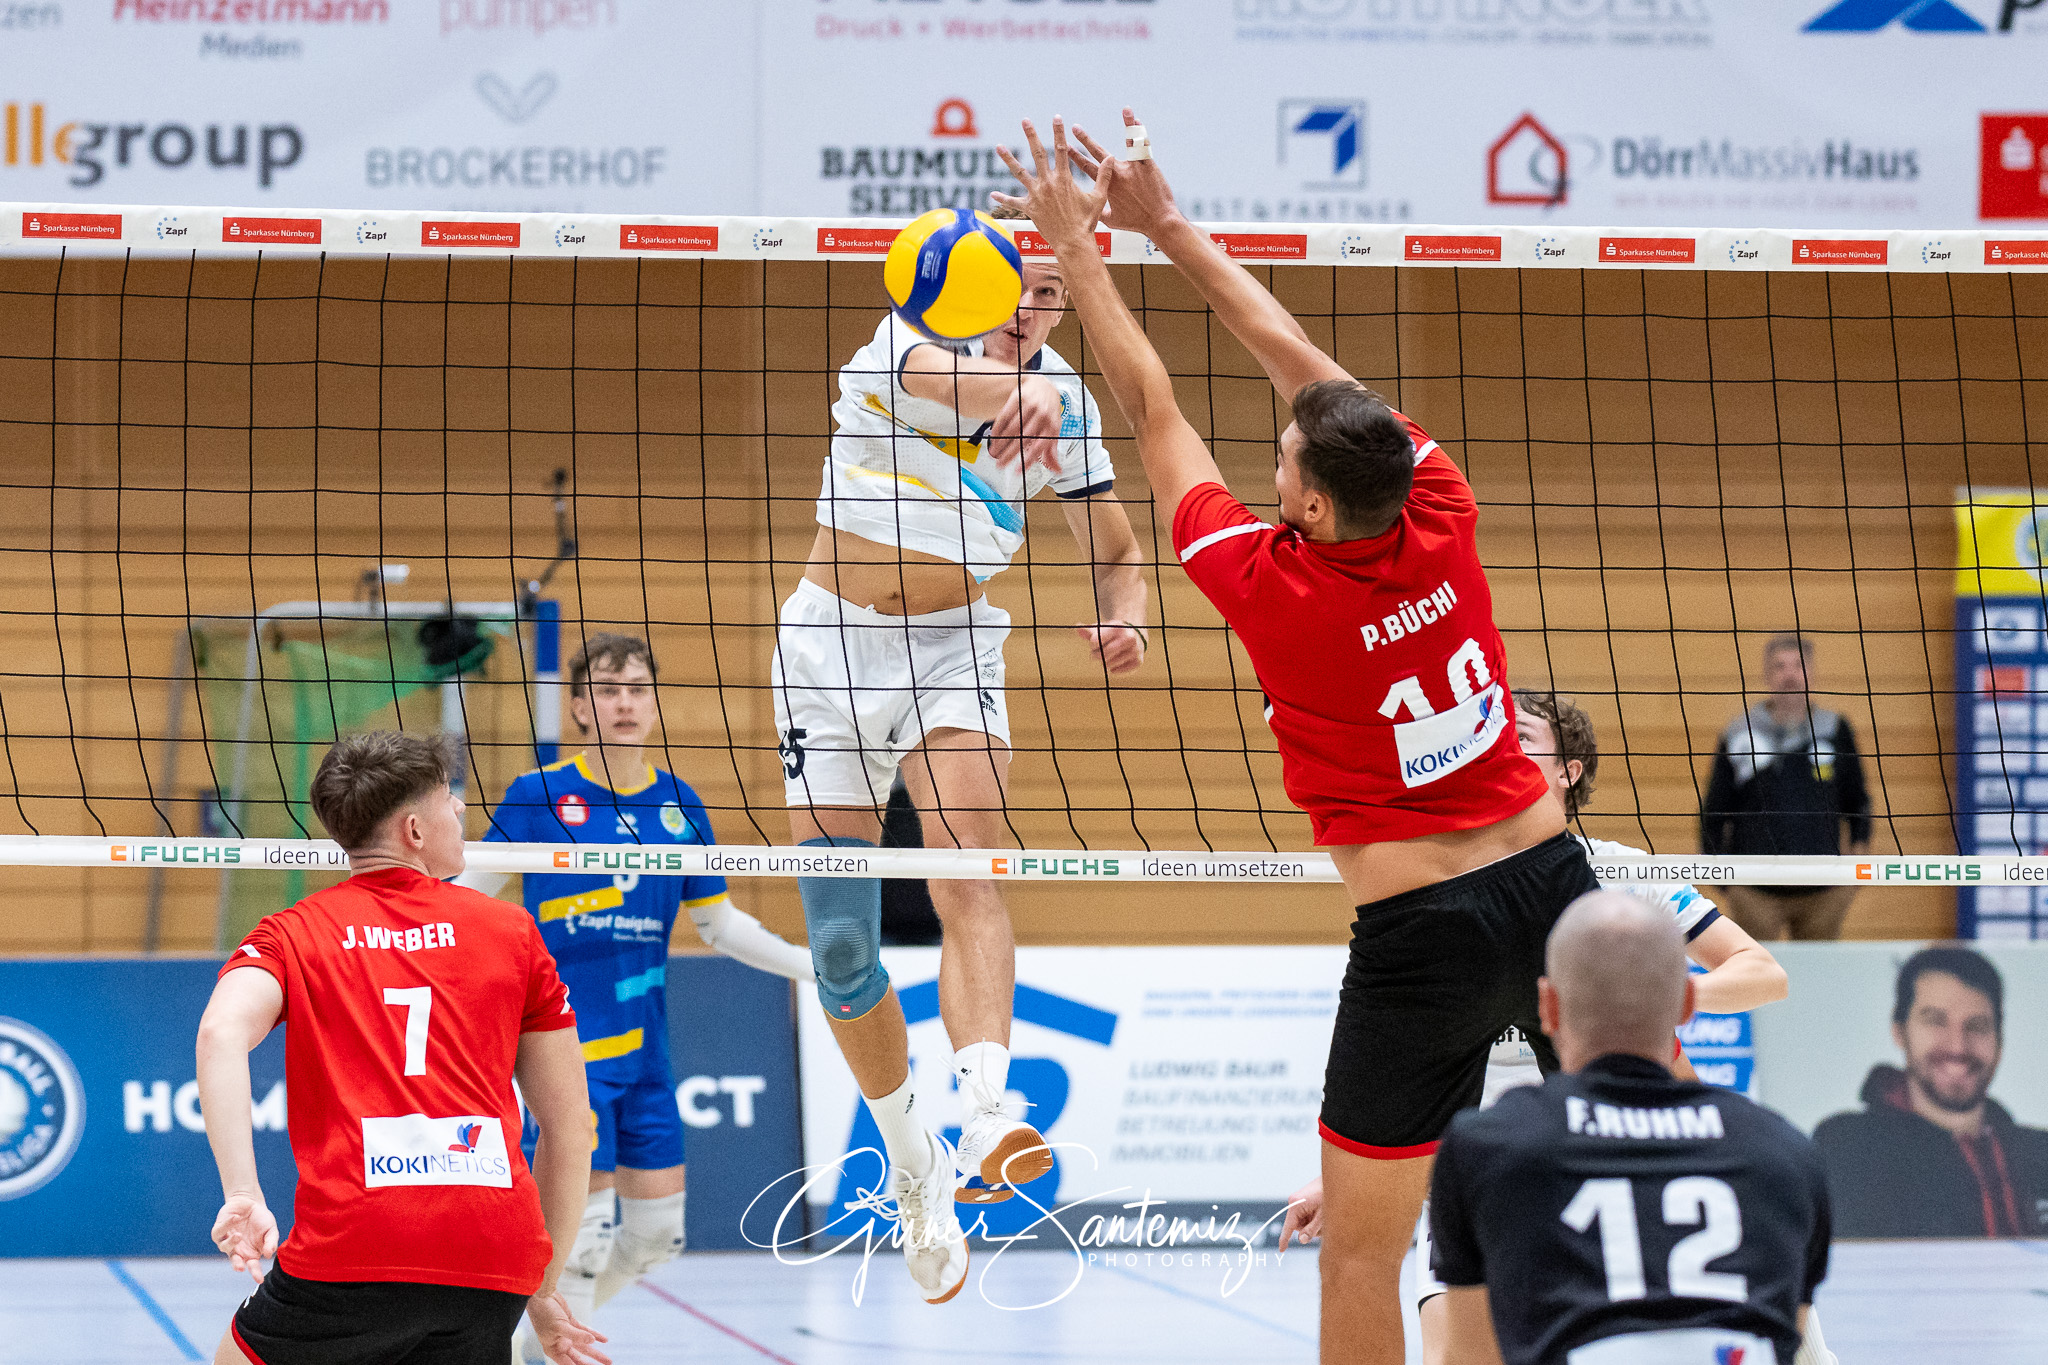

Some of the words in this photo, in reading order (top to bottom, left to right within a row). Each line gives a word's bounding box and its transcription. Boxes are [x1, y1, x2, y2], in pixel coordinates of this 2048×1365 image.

[366, 146, 668, 188] BROCKERHOF
[43, 224, 80, 234] Sparkasse
[81, 225, 115, 235] Nürnberg
[165, 227, 188, 237] Zapf
[243, 228, 280, 238] Sparkasse
[280, 229, 315, 239] Nürnberg
[365, 231, 387, 242] Zapf
[442, 232, 479, 242] Sparkasse
[480, 233, 513, 243] Nürnberg
[563, 235, 586, 245] Zapf
[640, 236, 677, 246] Sparkasse
[677, 237, 711, 247] Nürnberg
[761, 238, 783, 249] Zapf
[838, 239, 874, 249] Sparkasse
[874, 240, 895, 249] Nürn
[1230, 244, 1266, 254] Sparkasse
[1266, 245, 1300, 255] Nürnberg
[1349, 246, 1371, 256] Zapf
[1425, 246, 1461, 256] Sparkasse
[1461, 247, 1495, 257] Nürnberg
[1543, 248, 1566, 258] Zapf
[1619, 248, 1655, 258] Sparkasse
[1655, 249, 1689, 259] Nürnberg
[1737, 250, 1759, 260] Zapf
[1812, 250, 1848, 260] Sparkasse
[1848, 251, 1881, 261] Nürnberg
[1930, 251, 1951, 261] Zapf
[2004, 251, 2040, 261] Sparkasse
[1360, 580, 1458, 652] P.BÜCHI
[140, 845, 241, 864] FUCHS
[263, 846, 320, 865] Ideen
[583, 851, 682, 870] FUCHS
[705, 852, 761, 871] Ideen
[768, 854, 869, 873] umsetzen
[1021, 858, 1120, 876] FUCHS
[1142, 858, 1197, 877] Ideen
[1205, 859, 1304, 878] umsetzen
[1637, 863, 1735, 880] umsetzen
[1885, 863, 1982, 880] FUCHS
[342, 922, 456, 952] J.WEBER
[383, 986, 432, 1076] 7
[370, 1152, 507, 1177] KOKINETICS
[1560, 1176, 1749, 1302] 12
